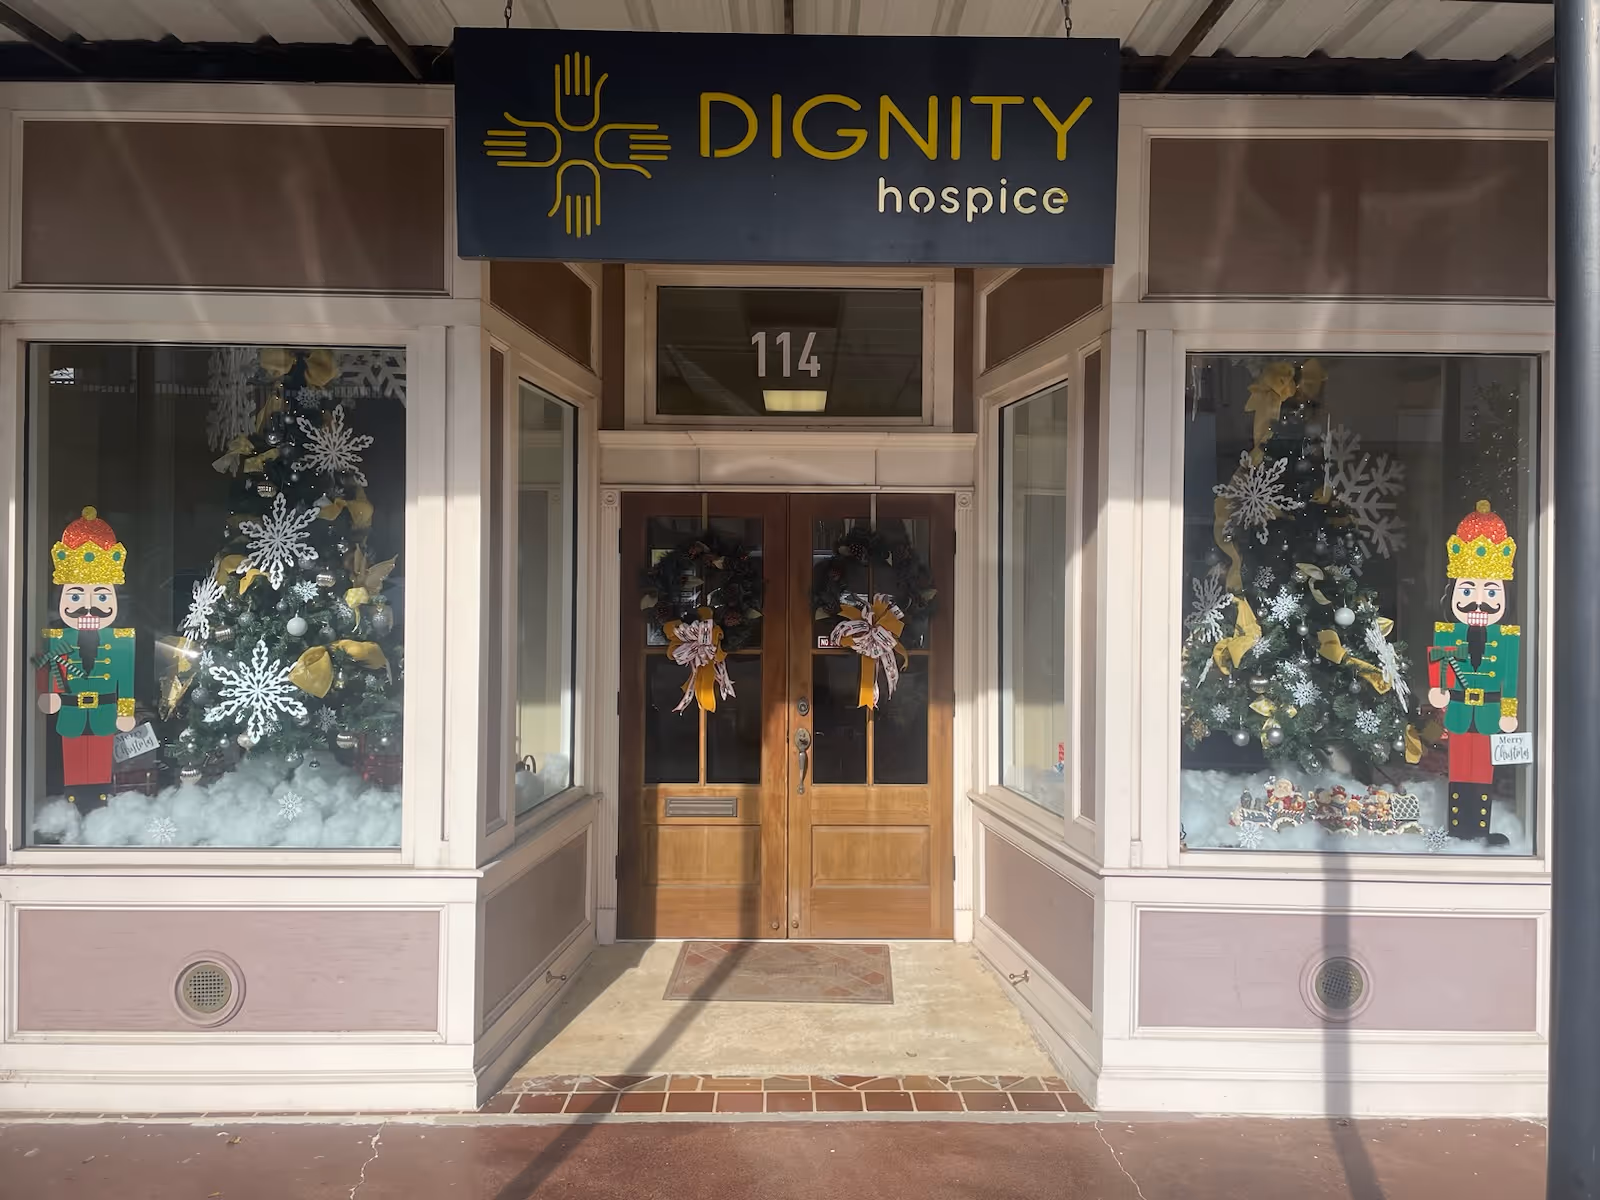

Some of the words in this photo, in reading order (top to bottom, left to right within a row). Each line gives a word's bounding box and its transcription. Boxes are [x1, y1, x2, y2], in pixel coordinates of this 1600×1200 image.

[699, 91, 1093, 162] DIGNITY
[878, 176, 1070, 223] hospice
[750, 330, 822, 379] 114
[820, 638, 829, 646] NO
[1499, 735, 1523, 745] Merry
